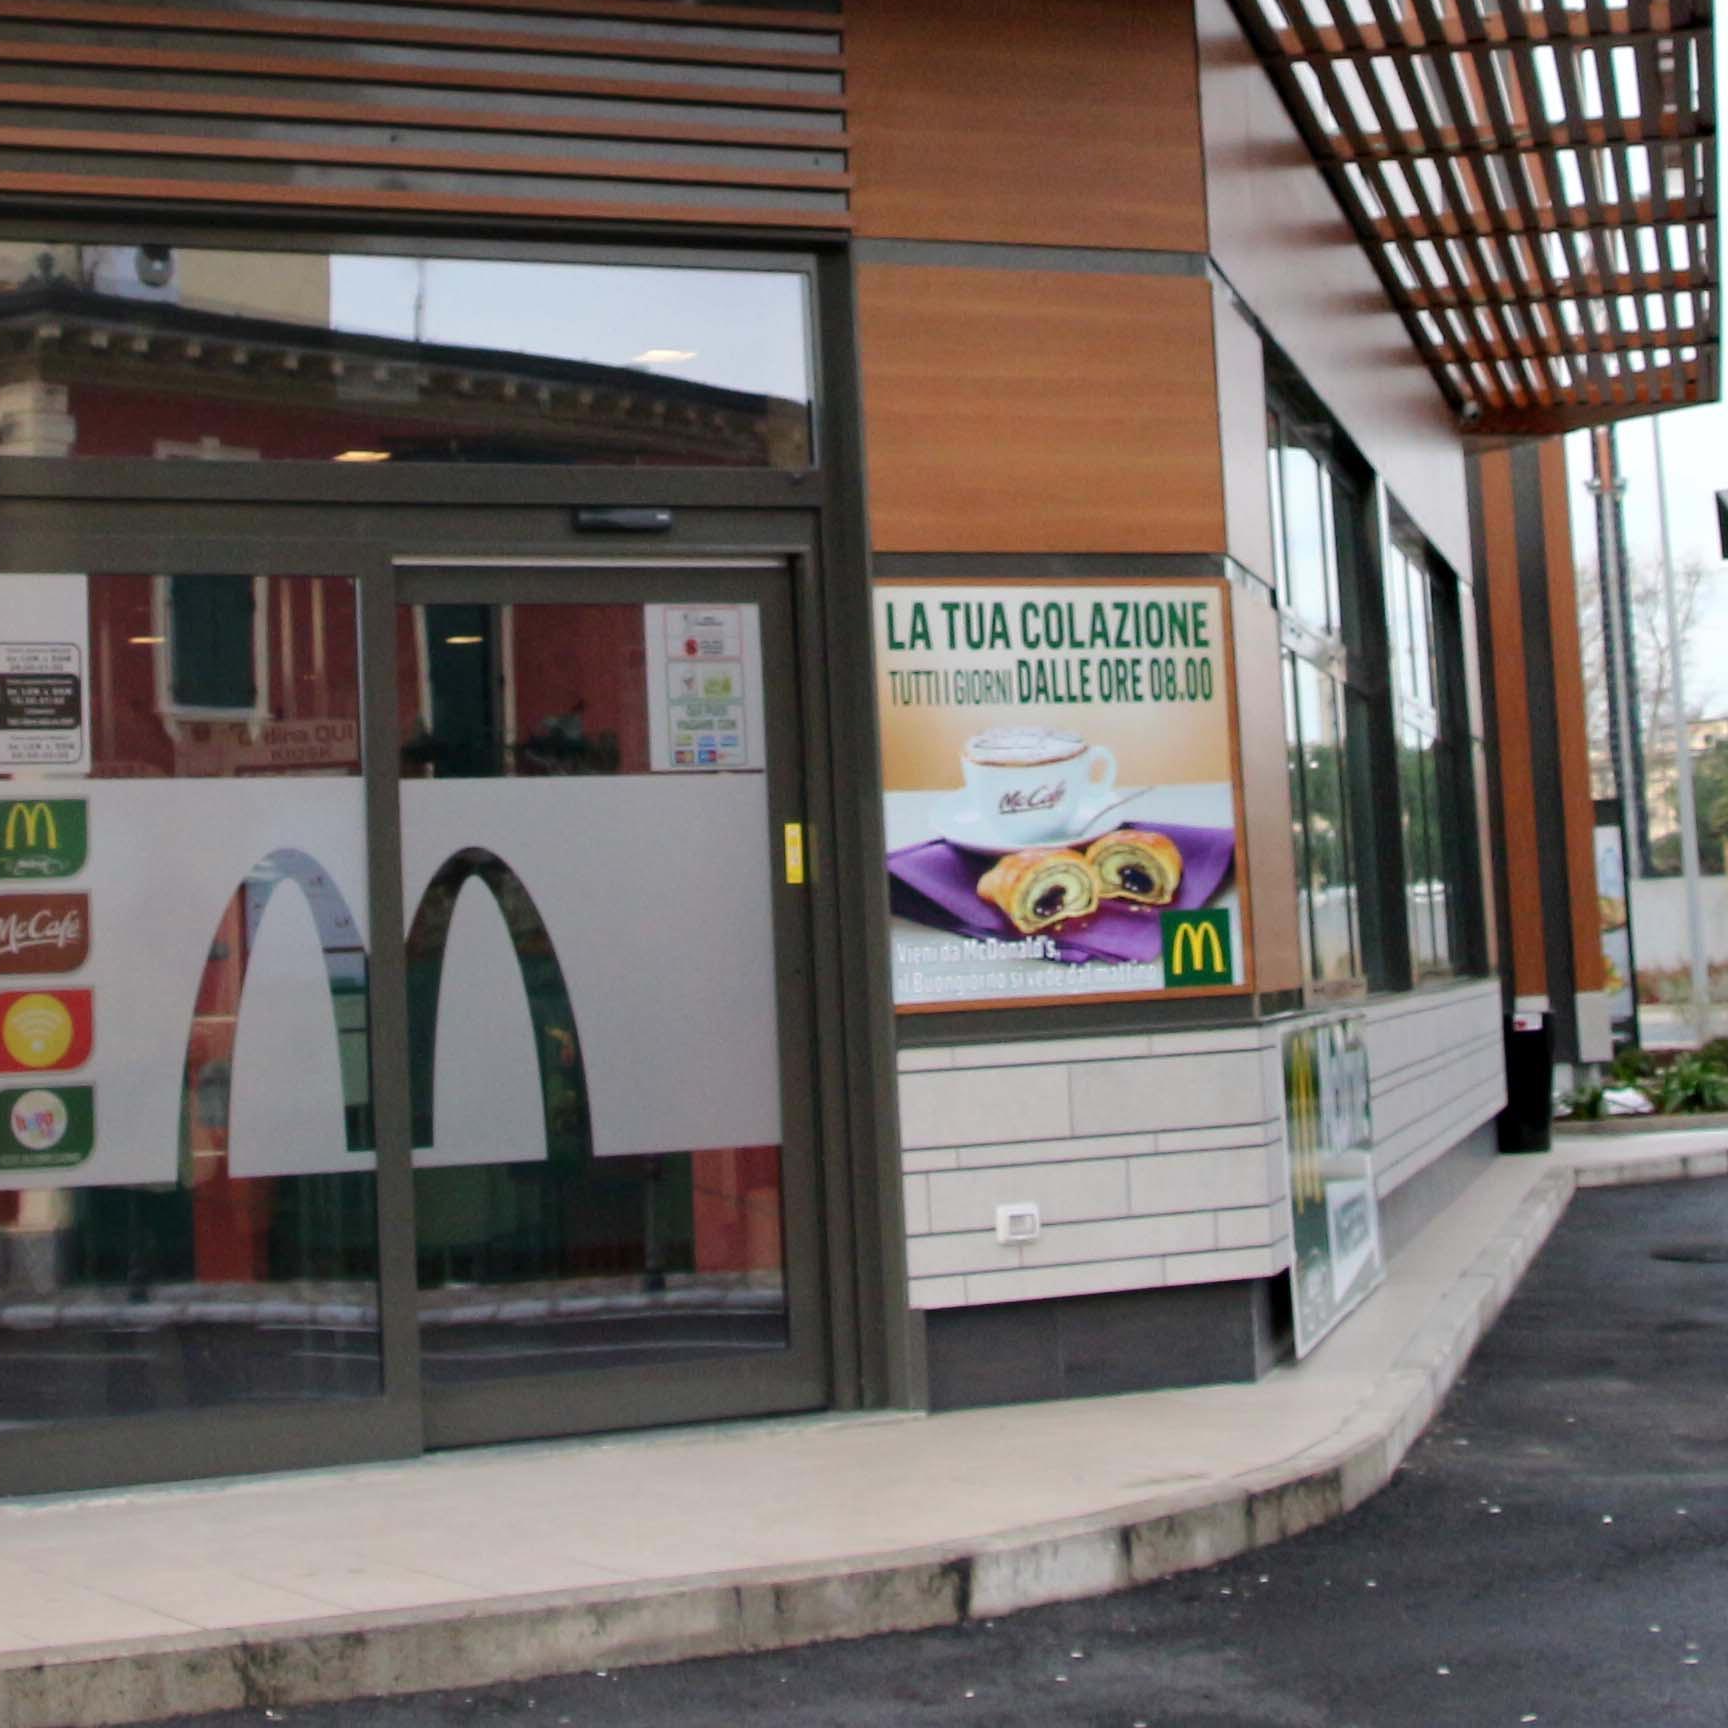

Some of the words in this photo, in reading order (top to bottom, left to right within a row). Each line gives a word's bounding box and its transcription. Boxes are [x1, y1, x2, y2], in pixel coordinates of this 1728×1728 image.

[885, 601, 933, 651] LA
[940, 601, 1012, 651] TUA
[1020, 600, 1210, 650] COLAZIONE
[888, 669, 941, 706] TUTTI
[943, 669, 951, 706] I
[953, 669, 1013, 705] GIORNI
[1017, 658, 1093, 704] DALLE
[1098, 658, 1144, 703] ORE
[1150, 656, 1214, 703] 08.00
[963, 934, 1062, 961] McDonald's,
